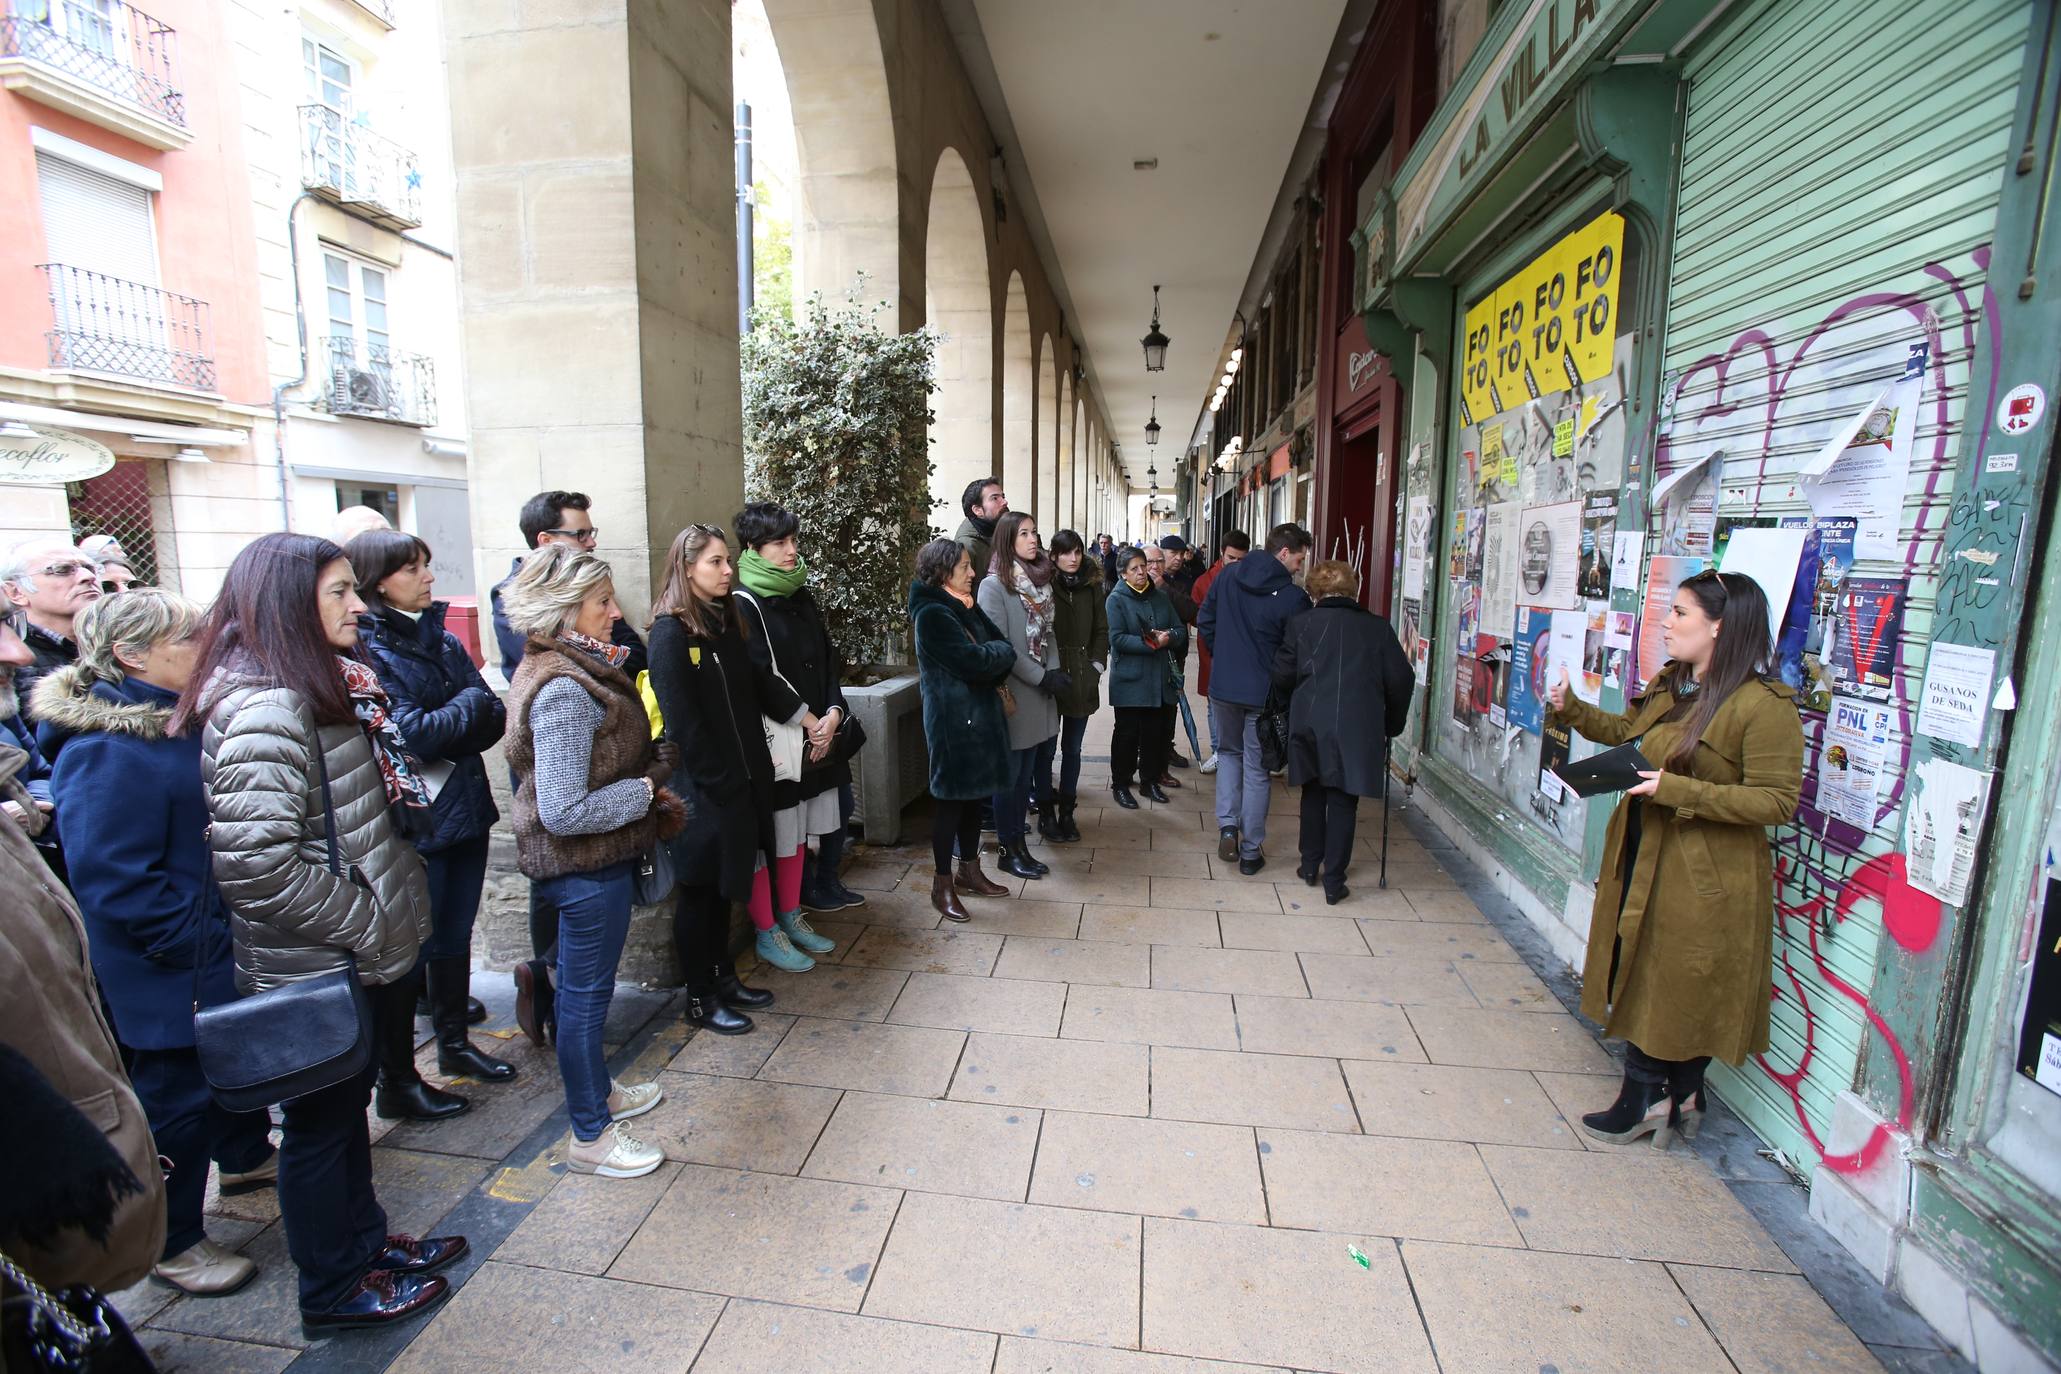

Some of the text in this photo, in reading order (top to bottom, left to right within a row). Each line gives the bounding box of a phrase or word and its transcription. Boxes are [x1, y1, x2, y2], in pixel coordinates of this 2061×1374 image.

[1460, 0, 1595, 180] LA VILLA
[1576, 245, 1613, 300] FO
[1535, 272, 1565, 321] FO
[1499, 300, 1523, 342] FO
[1533, 315, 1562, 360] TO
[1574, 293, 1609, 344] TO
[1469, 323, 1489, 362] FO
[1497, 339, 1521, 377] TO
[1467, 358, 1488, 394] TO
[1783, 521, 1855, 529] VUELOS BIPLAZA
[1929, 681, 1977, 699] GUSANOS
[1931, 695, 1973, 713] DE SEDA
[1836, 707, 1867, 731] PNL
[1875, 721, 1887, 730] CPI
